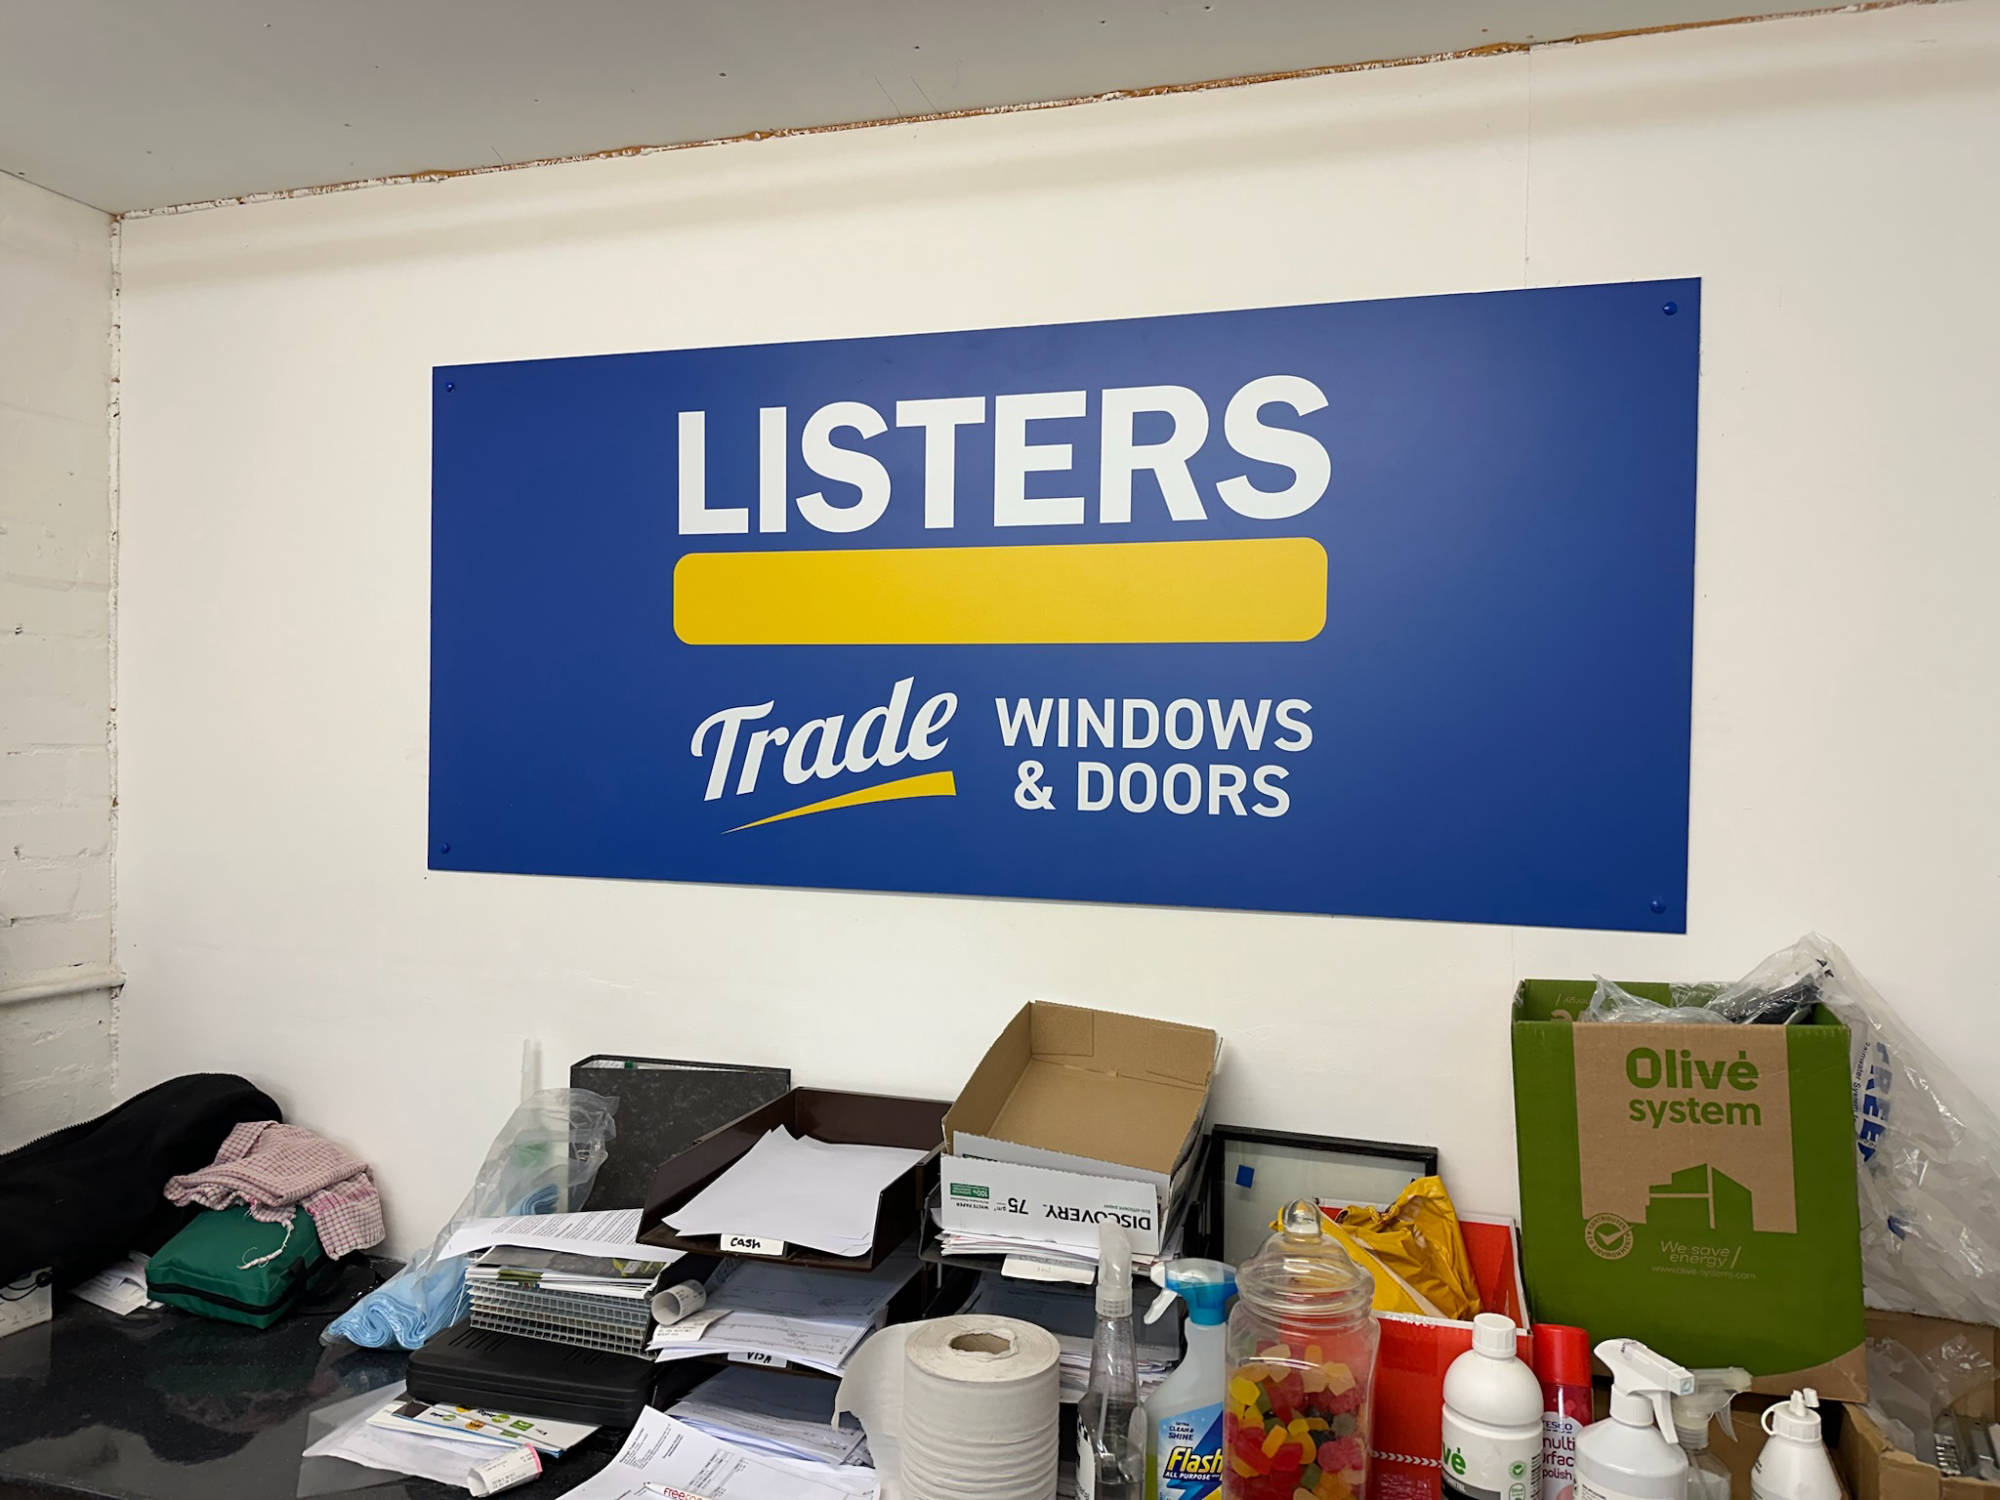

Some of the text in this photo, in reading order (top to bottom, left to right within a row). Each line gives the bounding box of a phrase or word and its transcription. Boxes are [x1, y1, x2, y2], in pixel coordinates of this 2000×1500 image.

[679, 375, 1331, 534] LISTERS
[995, 697, 1314, 753] WINDOWS
[690, 676, 959, 802] Trade
[1013, 760, 1291, 818] & DOORS
[1629, 1097, 1761, 1129] system
[1008, 1197, 1029, 1215] 75
[1660, 1240, 1730, 1257] We save
[1669, 1252, 1728, 1268] energy
[1167, 1446, 1223, 1473] Flash
[1178, 1472, 1211, 1480] PURPOSE
[1542, 1468, 1573, 1481] polish
